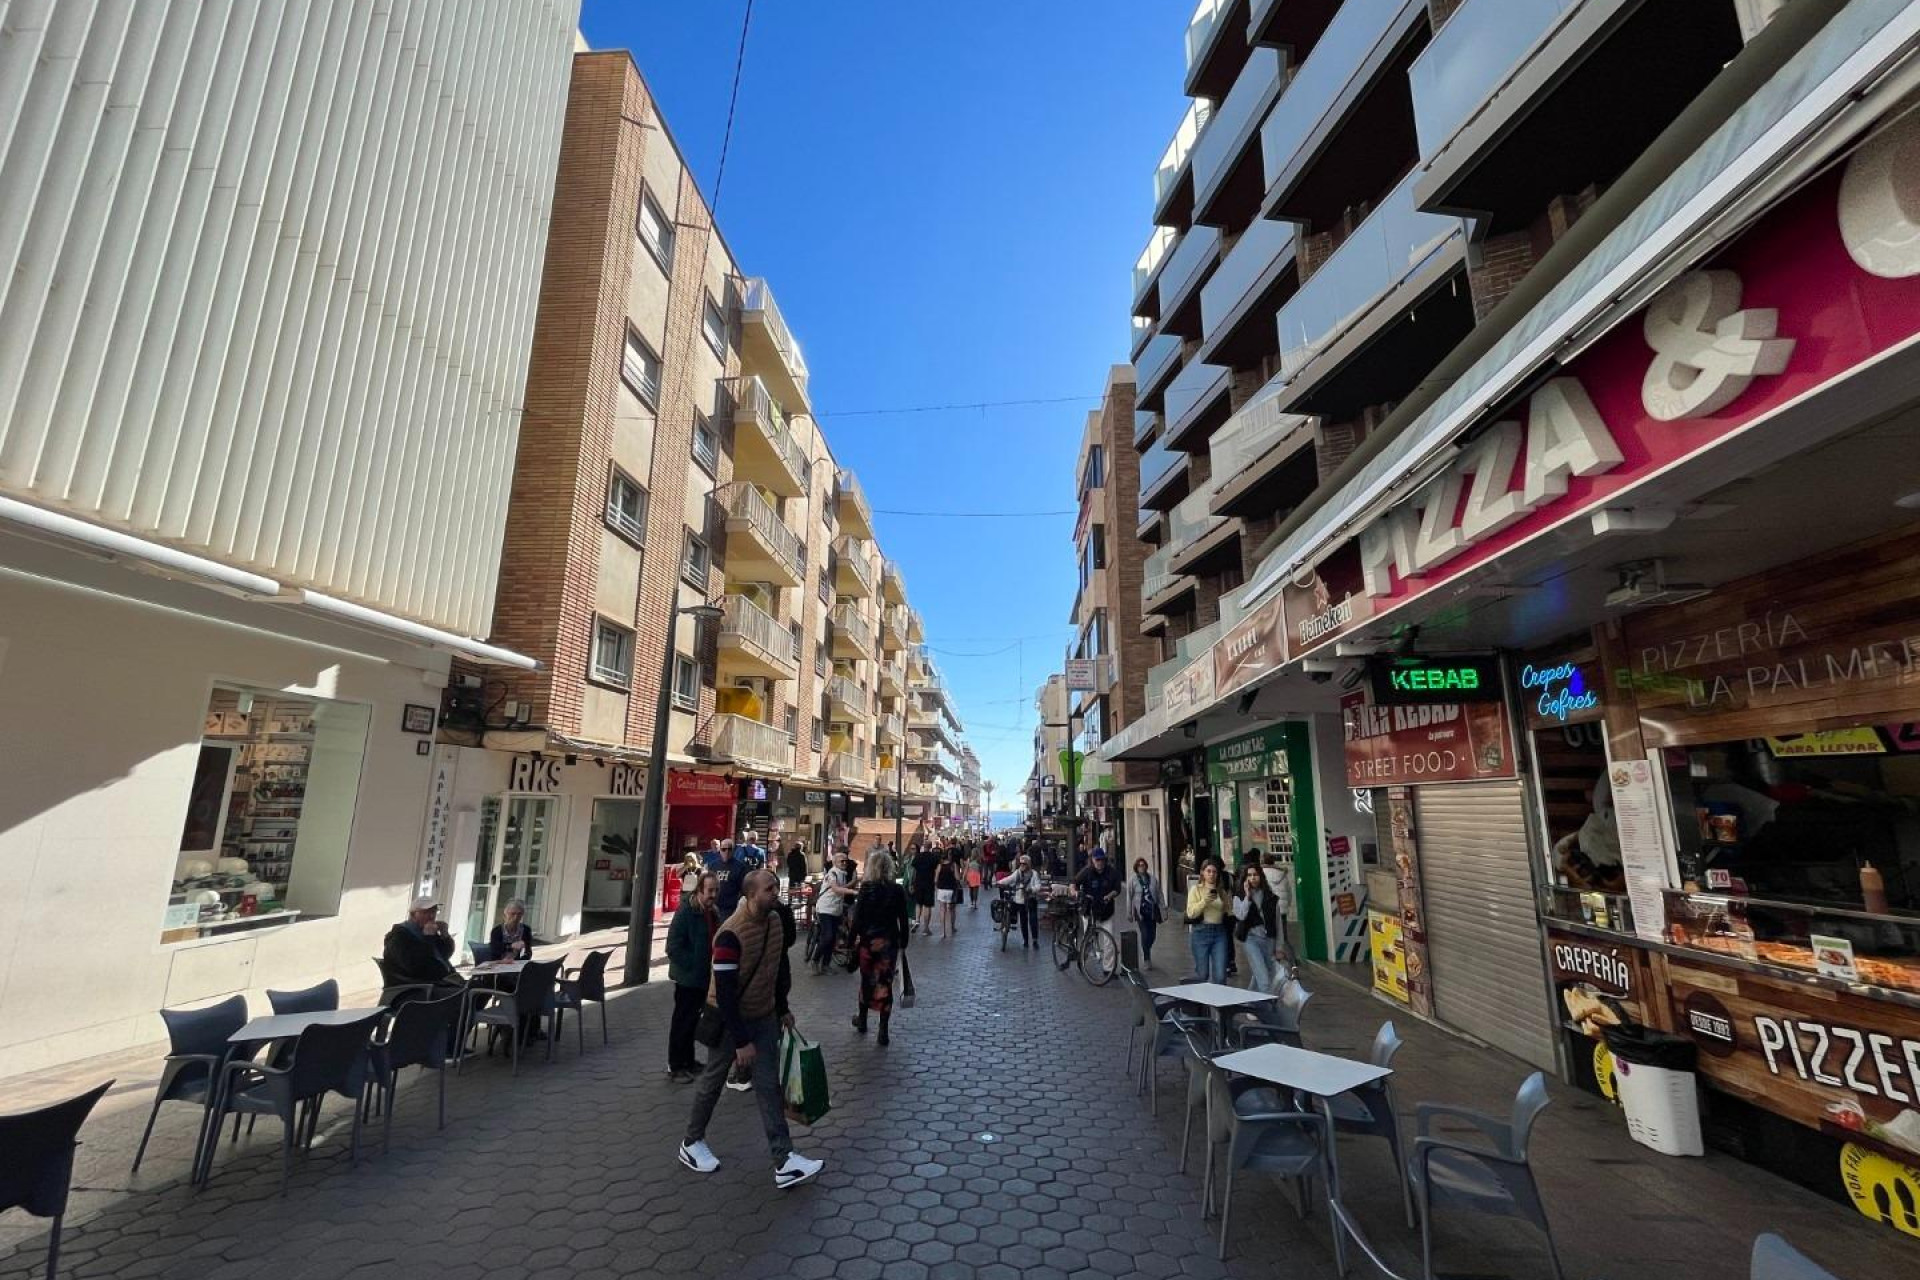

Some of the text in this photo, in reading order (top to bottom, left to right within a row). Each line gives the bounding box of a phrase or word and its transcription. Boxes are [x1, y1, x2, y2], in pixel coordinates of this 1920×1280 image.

[1360, 270, 1797, 598] PIZZA &
[1299, 592, 1353, 645] Heineken
[1642, 610, 1808, 673] PIZZERÍA
[1391, 668, 1479, 690] KEBAB
[1522, 662, 1576, 692] Crepes
[1687, 674, 1736, 707] LA
[1538, 687, 1597, 721] Gofres
[1776, 742, 1879, 754] PARA LLEVAR
[510, 757, 561, 792] RKS
[1354, 750, 1457, 779] STREET FOOD
[611, 766, 650, 796] RKS
[1712, 871, 1728, 882] 70
[1555, 944, 1629, 991] CREPERÍA
[1691, 1014, 1713, 1032] DESDE
[1846, 1172, 1866, 1199] POR
